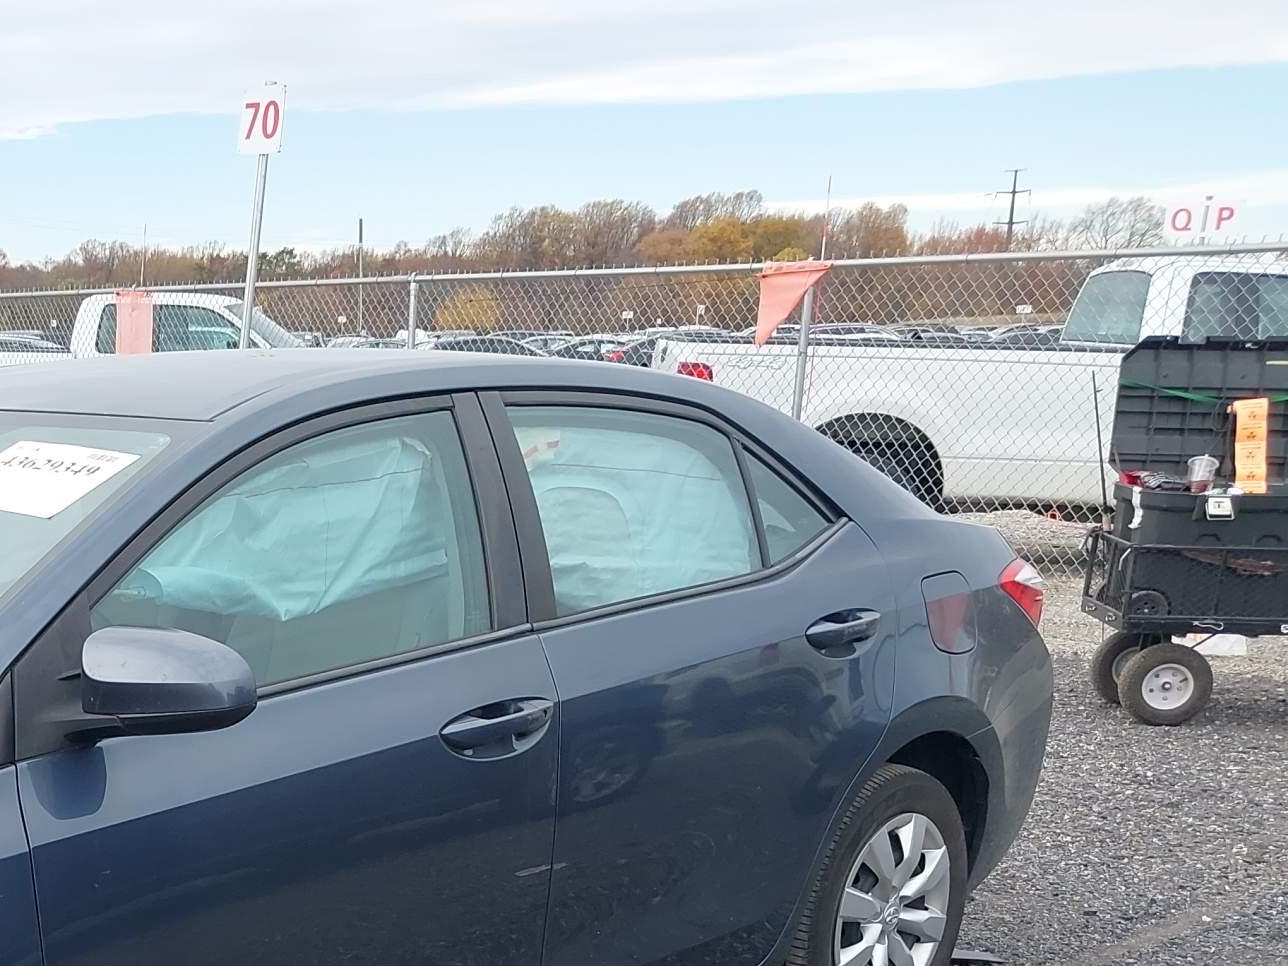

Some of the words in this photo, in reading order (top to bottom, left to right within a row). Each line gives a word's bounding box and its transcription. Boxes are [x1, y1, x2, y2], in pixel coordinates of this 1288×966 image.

[245, 99, 280, 140] 70
[1171, 208, 1192, 231] Q
[1216, 207, 1234, 230] P
[0, 455, 102, 476] 43629349
